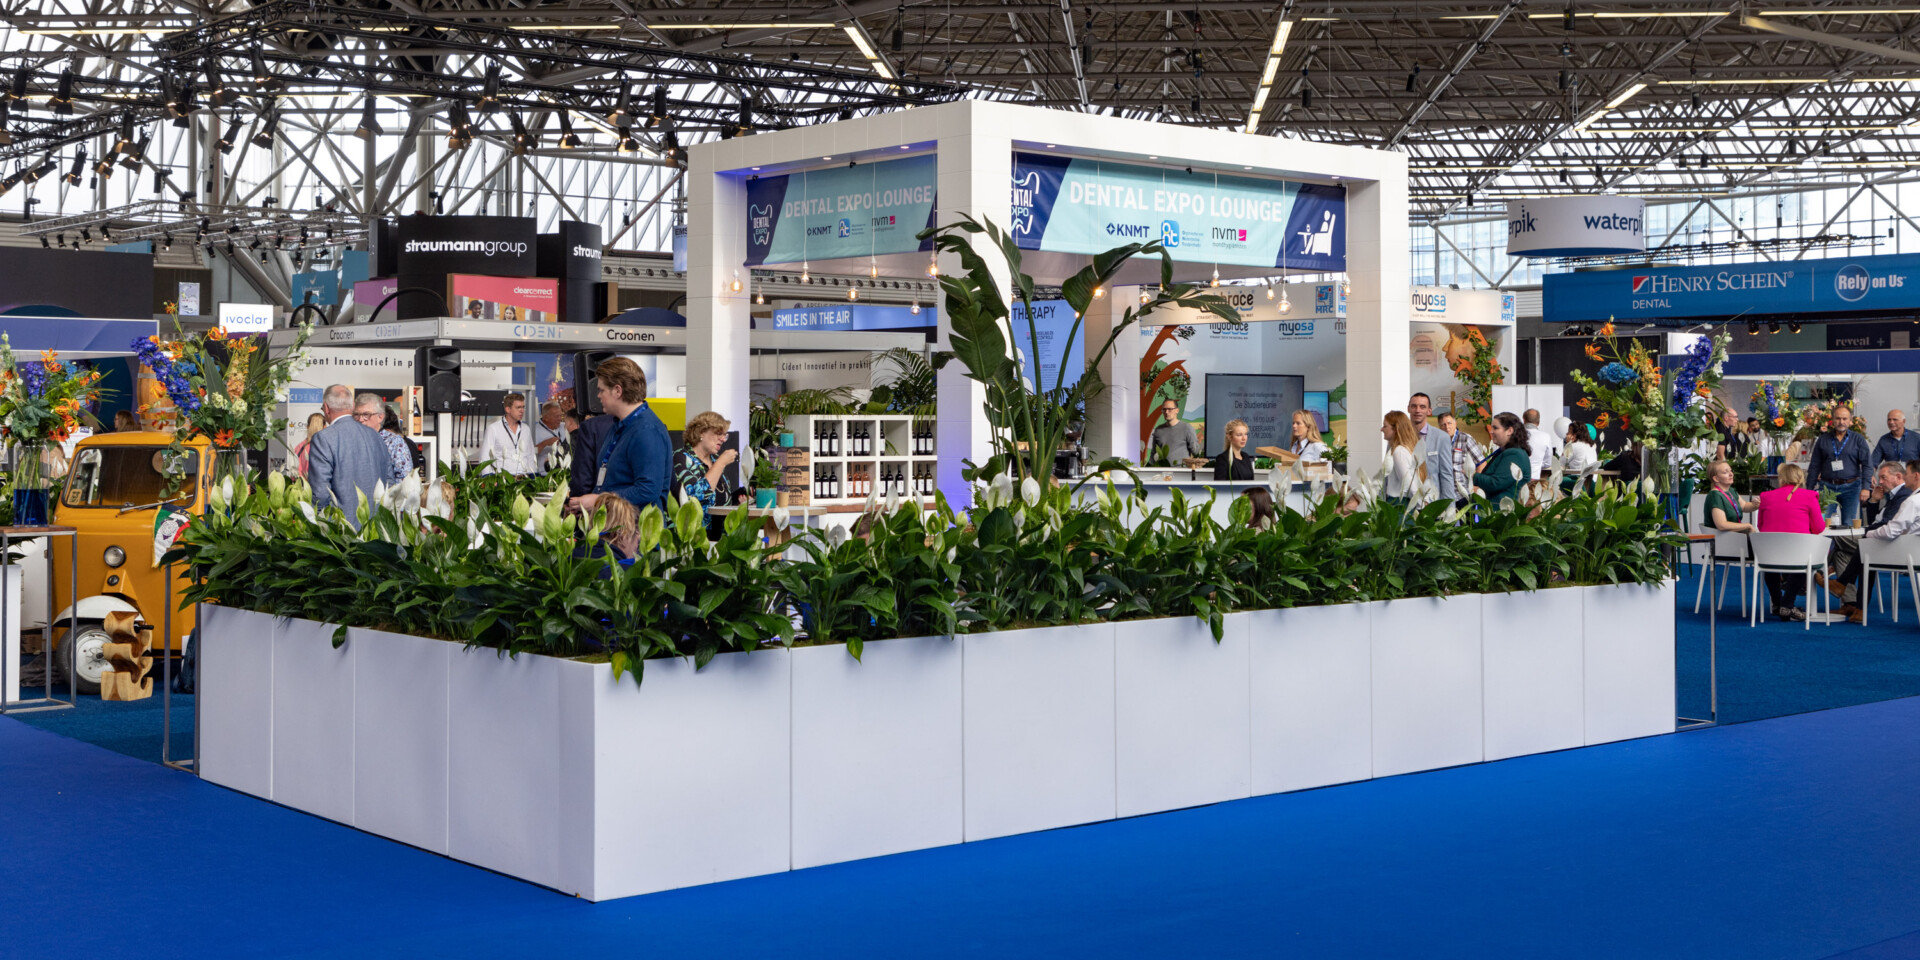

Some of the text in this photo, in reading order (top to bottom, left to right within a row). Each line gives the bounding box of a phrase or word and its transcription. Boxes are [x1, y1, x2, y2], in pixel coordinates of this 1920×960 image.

[785, 185, 932, 218] DENTAL EXPO LOUNGE
[1070, 181, 1282, 223] DENTAL EXPO LOUNGE
[753, 216, 769, 229] DENTAL
[812, 225, 832, 236] KNMT
[1117, 223, 1150, 238] KNMT
[1212, 227, 1237, 241] nvm
[405, 240, 527, 257] straumanngroup
[1651, 275, 1714, 293] HENRY
[1838, 274, 1867, 291] Rely
[1872, 278, 1886, 288] on
[1412, 290, 1446, 312] myosa
[1632, 299, 1671, 309] DENTAL
[226, 312, 268, 324] ivoclar
[776, 310, 850, 328] SMILE IS IN THE AIR
[1012, 305, 1056, 320] THERAPY
[330, 329, 355, 339] Croonen
[1279, 320, 1315, 336] myosa
[606, 329, 656, 342] Croonen
[1835, 336, 1870, 346] reveal
[334, 356, 388, 367] Innovatief
[394, 358, 403, 366] in
[781, 363, 801, 371] Cident
[804, 361, 837, 370] Innovatief
